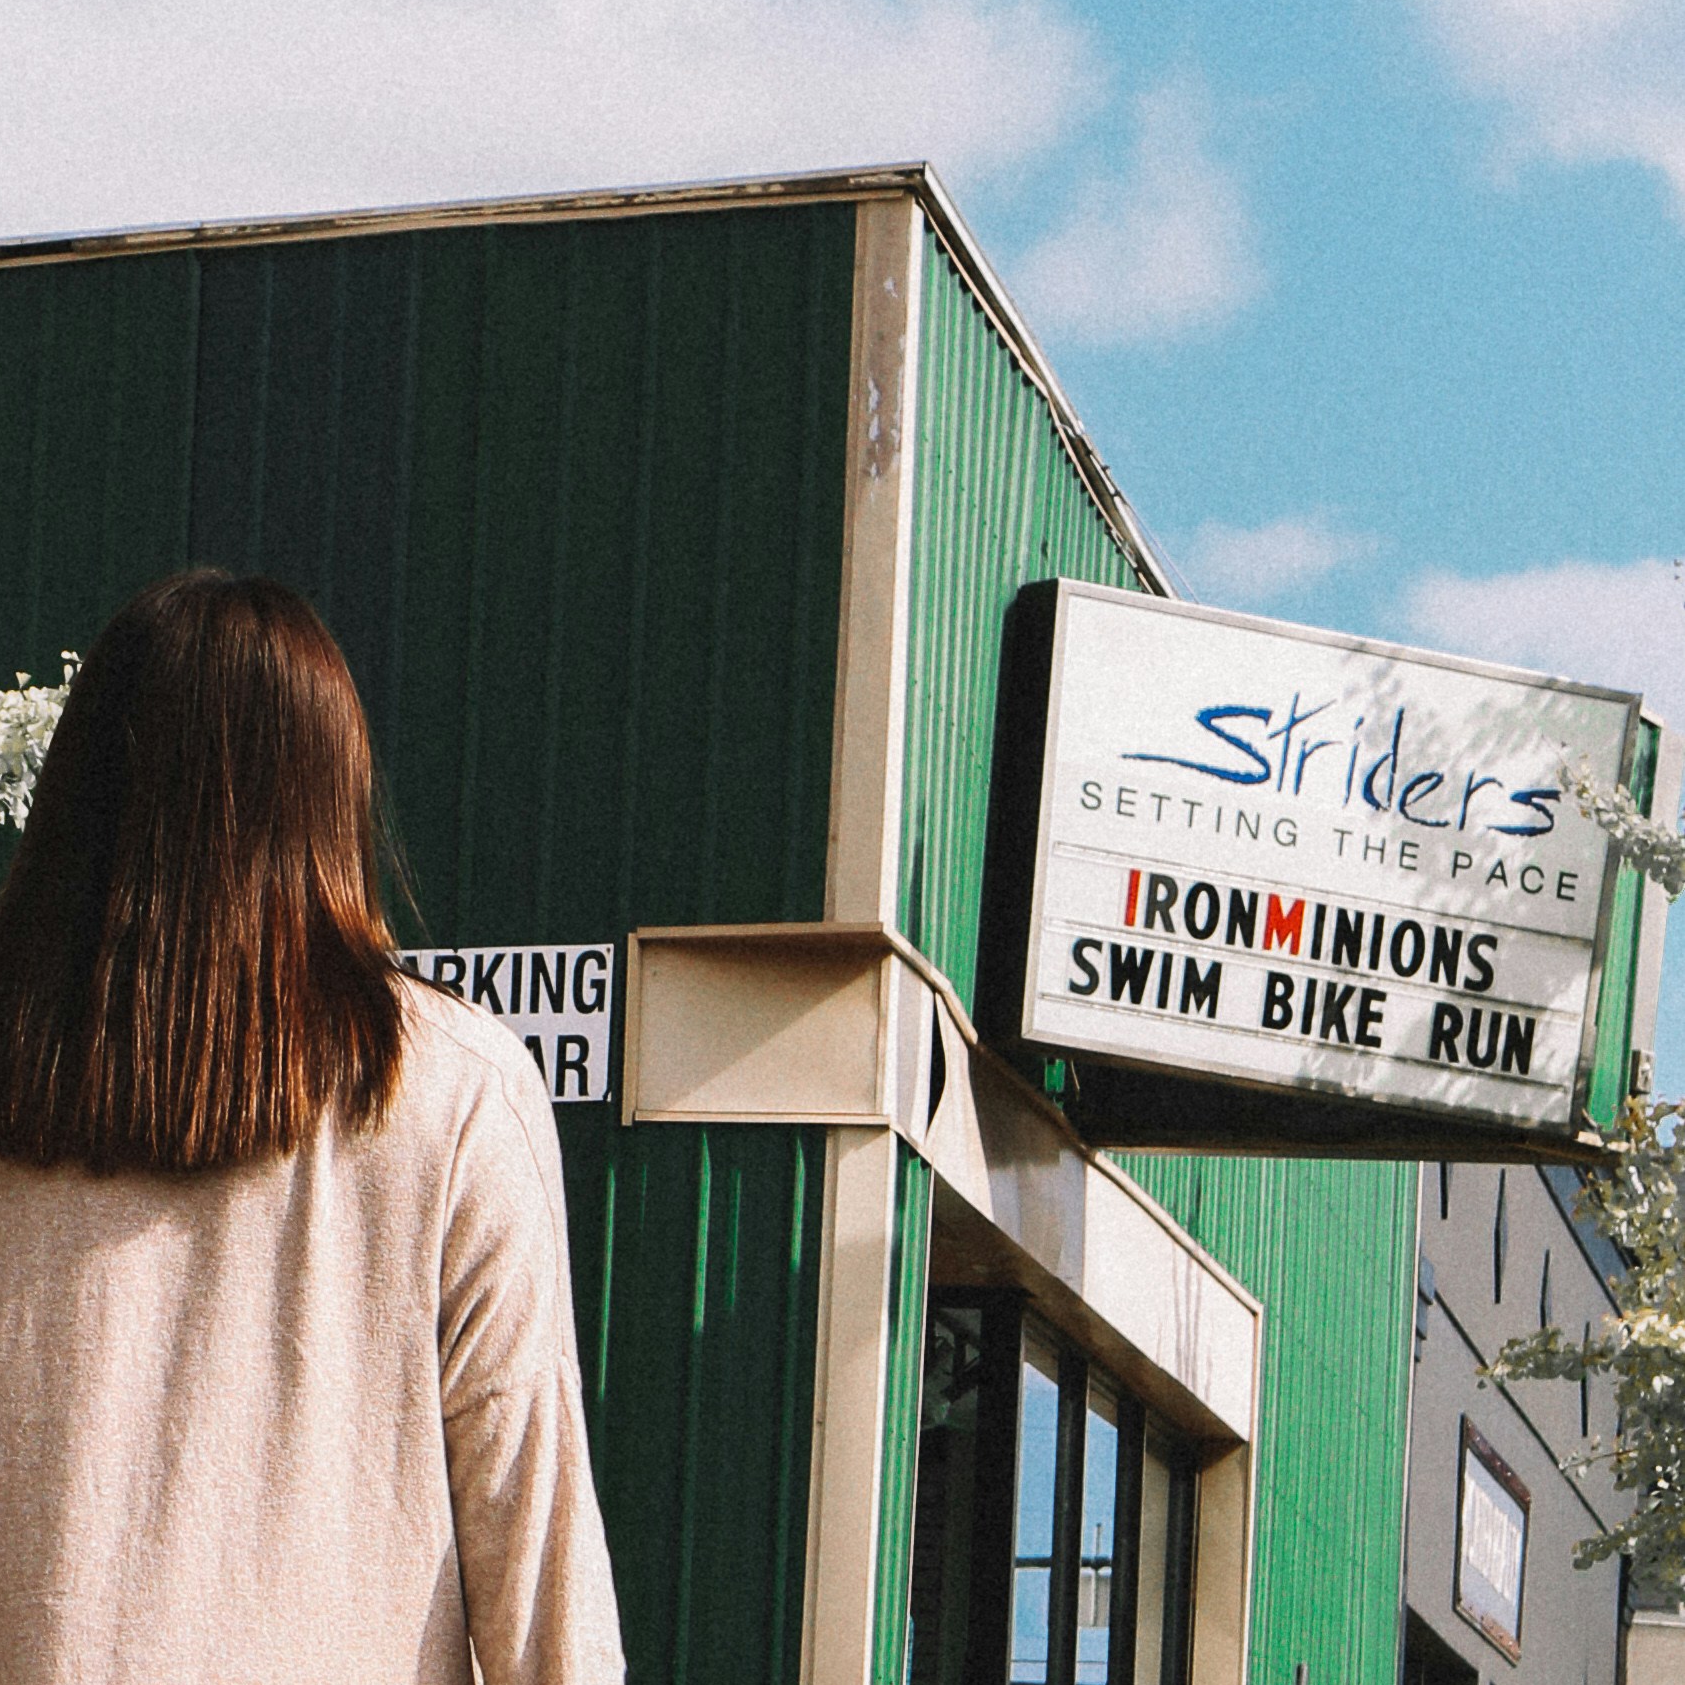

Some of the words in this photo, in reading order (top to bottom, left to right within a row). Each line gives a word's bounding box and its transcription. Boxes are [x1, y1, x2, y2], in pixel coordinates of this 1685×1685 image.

[1121, 691, 1561, 837] Striders
[1080, 780, 1298, 847] SETTING
[1333, 828, 1418, 872] THE
[1452, 850, 1579, 902] PACE
[404, 950, 607, 1014] RKING
[1124, 868, 1498, 992] IRONMINIONS
[1069, 938, 1223, 1019] SWIM
[1261, 971, 1387, 1048] BIKE
[1429, 1002, 1536, 1076] RUN
